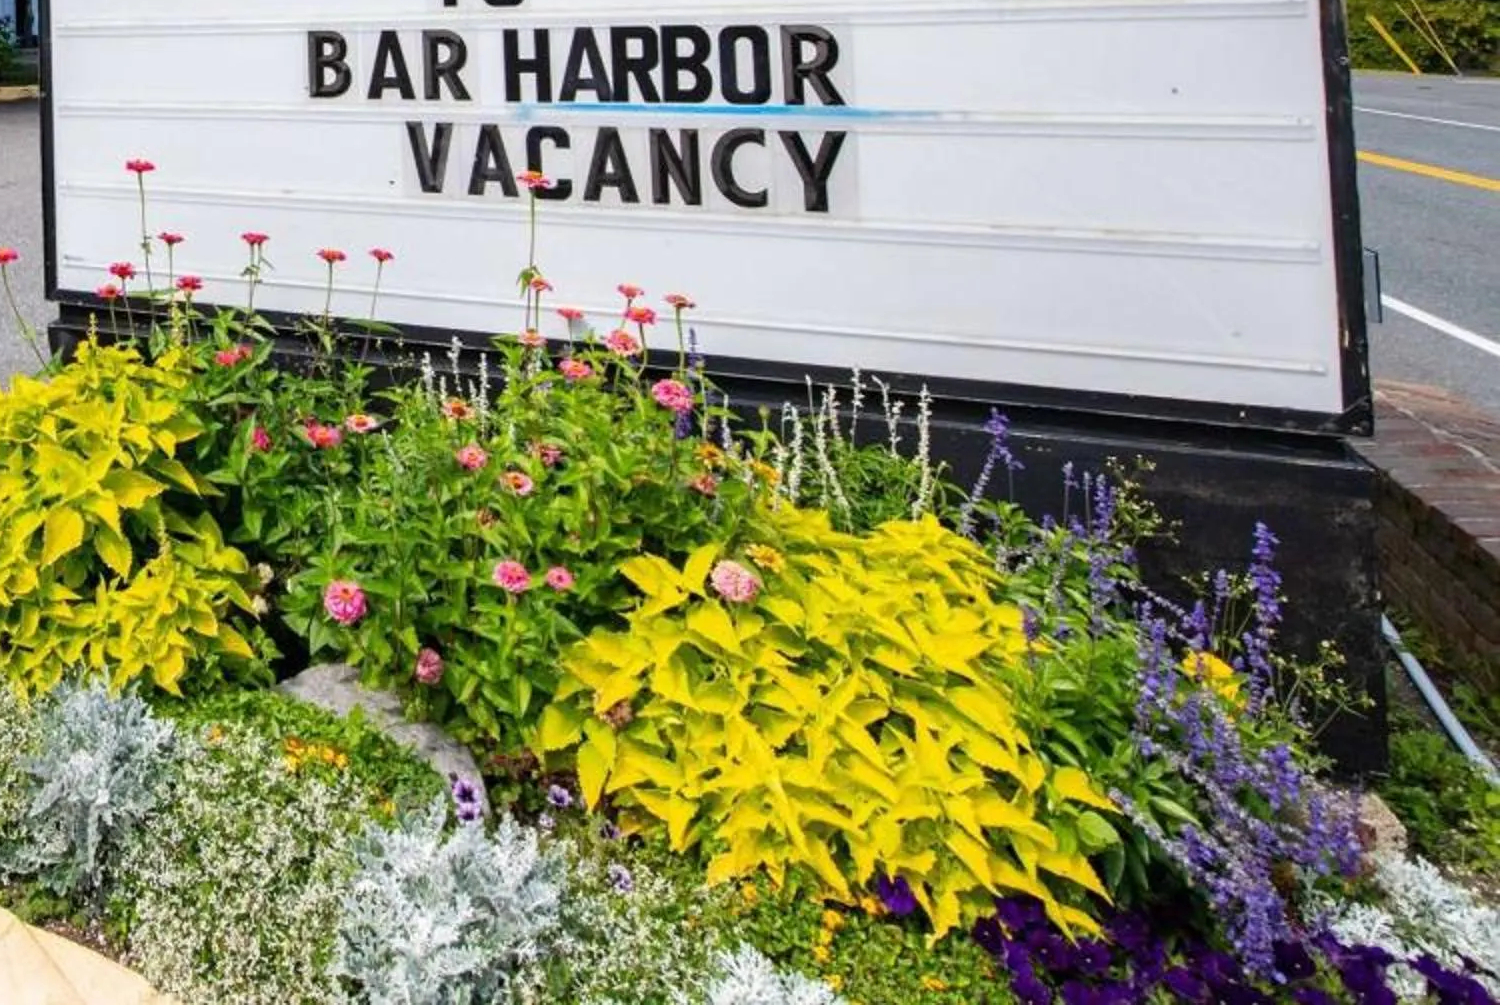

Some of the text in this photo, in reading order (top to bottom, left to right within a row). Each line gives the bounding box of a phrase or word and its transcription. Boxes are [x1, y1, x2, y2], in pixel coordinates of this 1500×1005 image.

[307, 24, 847, 106] BAR HARBOR
[406, 121, 847, 213] VACANCY
